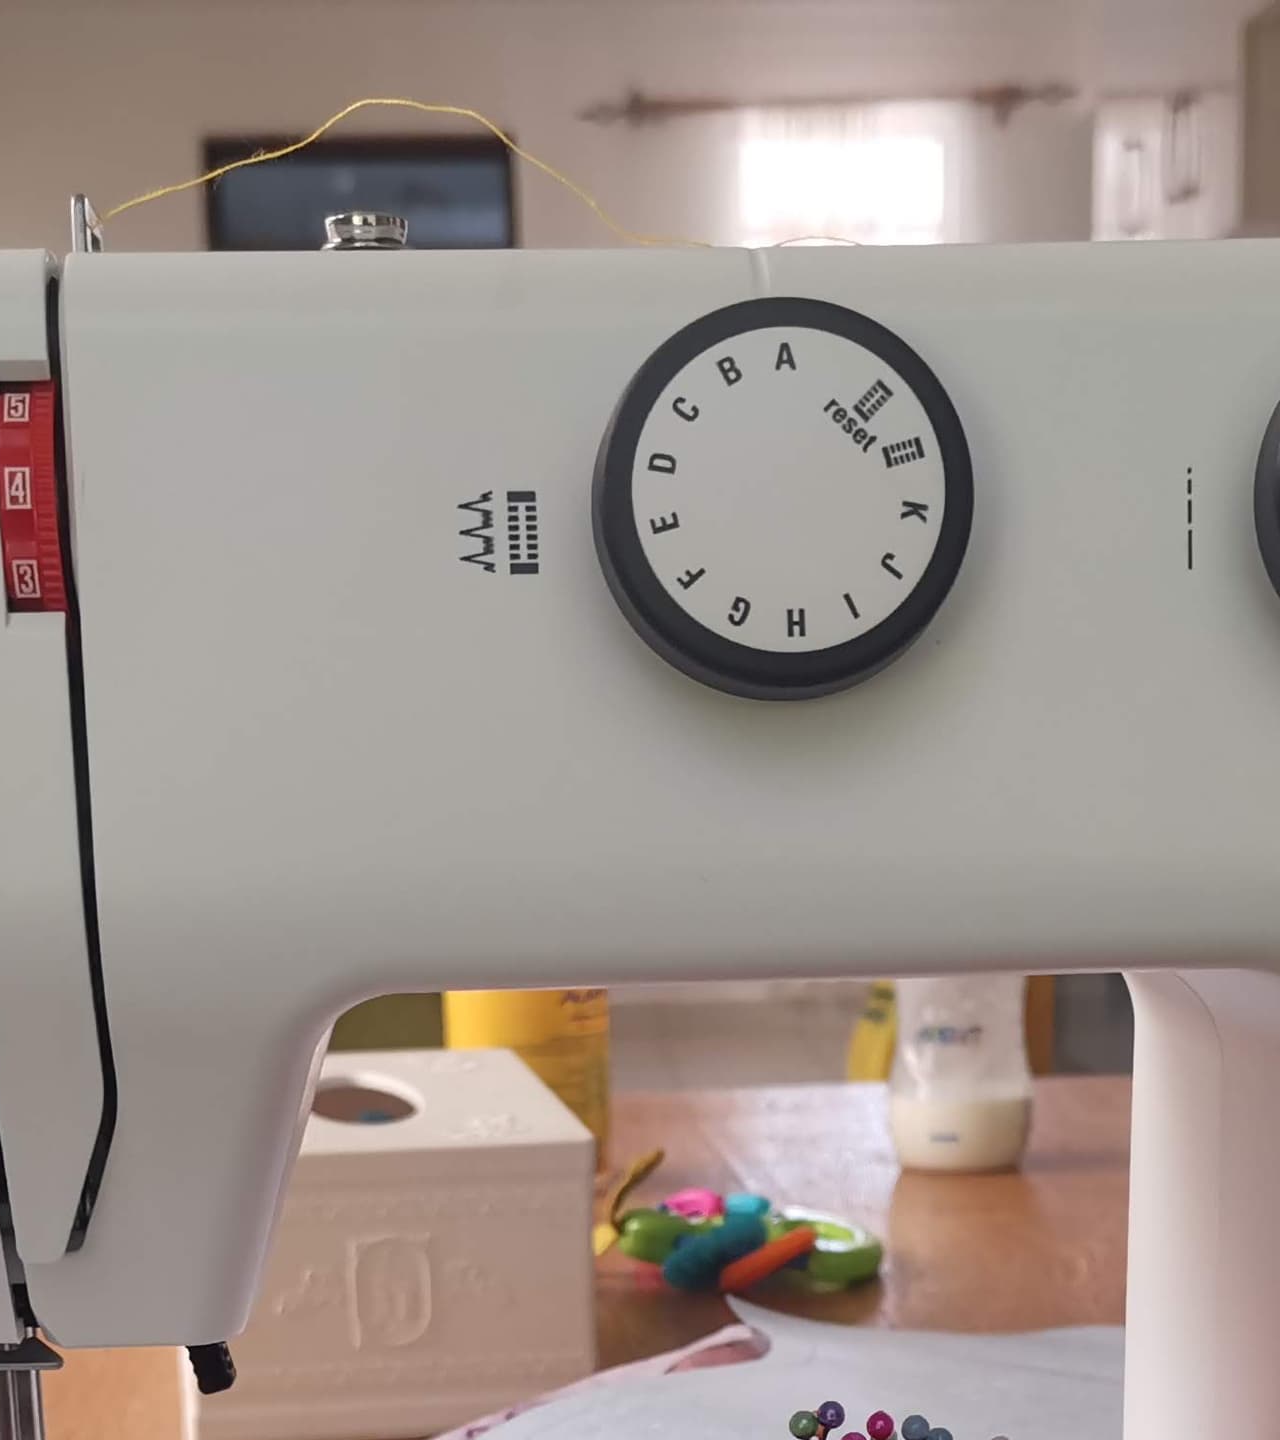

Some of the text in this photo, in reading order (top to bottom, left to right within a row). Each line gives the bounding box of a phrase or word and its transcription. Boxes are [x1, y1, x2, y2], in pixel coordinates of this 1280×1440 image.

[774, 341, 797, 371] A
[716, 355, 743, 387] B
[10, 396, 24, 418] 5
[671, 396, 700, 423] C
[823, 398, 877, 453] reset
[647, 452, 677, 475] D
[10, 472, 24, 503] 4
[650, 511, 680, 535] E
[900, 500, 929, 524] K
[19, 564, 34, 594] 3
[676, 566, 706, 590] F
[880, 552, 904, 580] J
[727, 596, 752, 627] G
[842, 592, 861, 620] I
[786, 607, 807, 638] H
